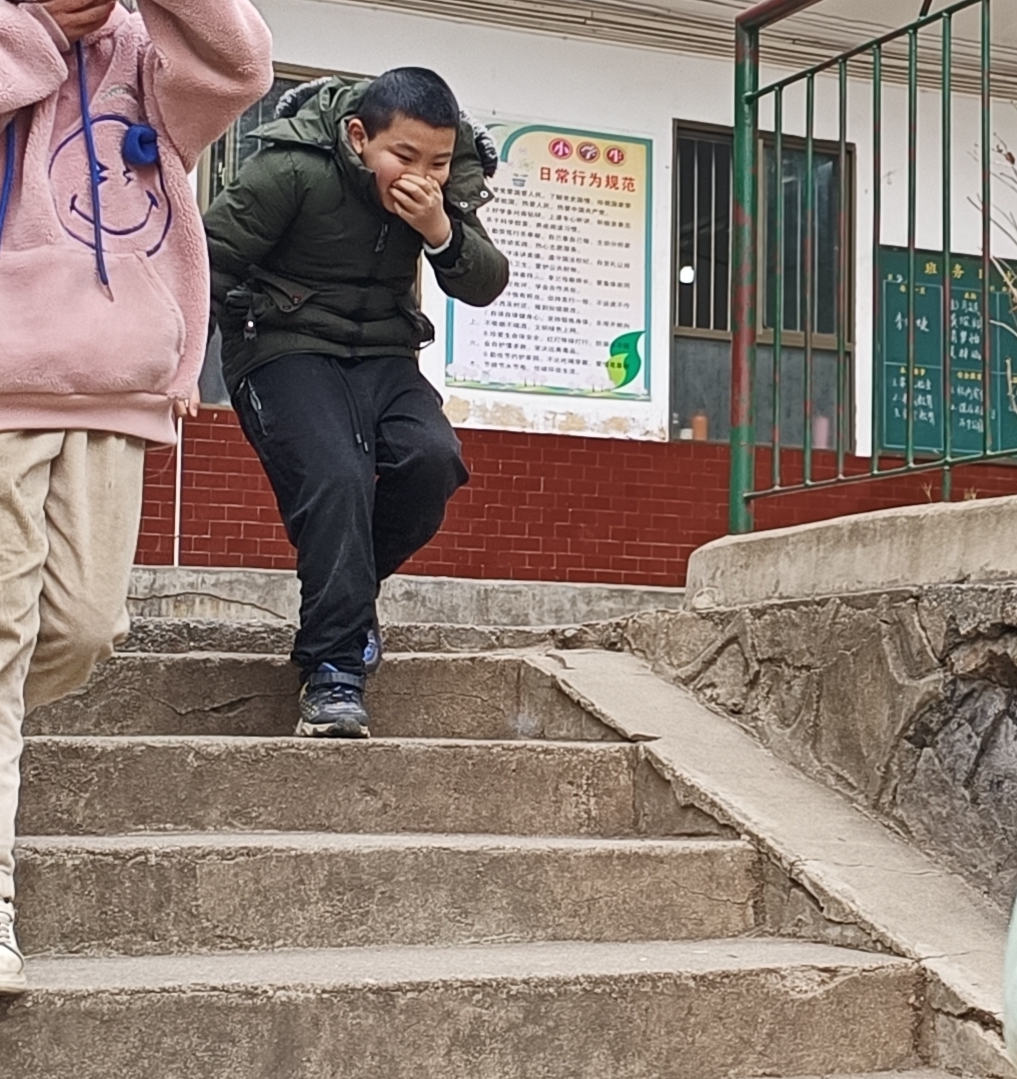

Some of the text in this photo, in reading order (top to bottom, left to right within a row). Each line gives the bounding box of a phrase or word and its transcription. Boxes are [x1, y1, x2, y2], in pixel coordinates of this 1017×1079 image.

[540, 166, 636, 193] 日常行为规范
